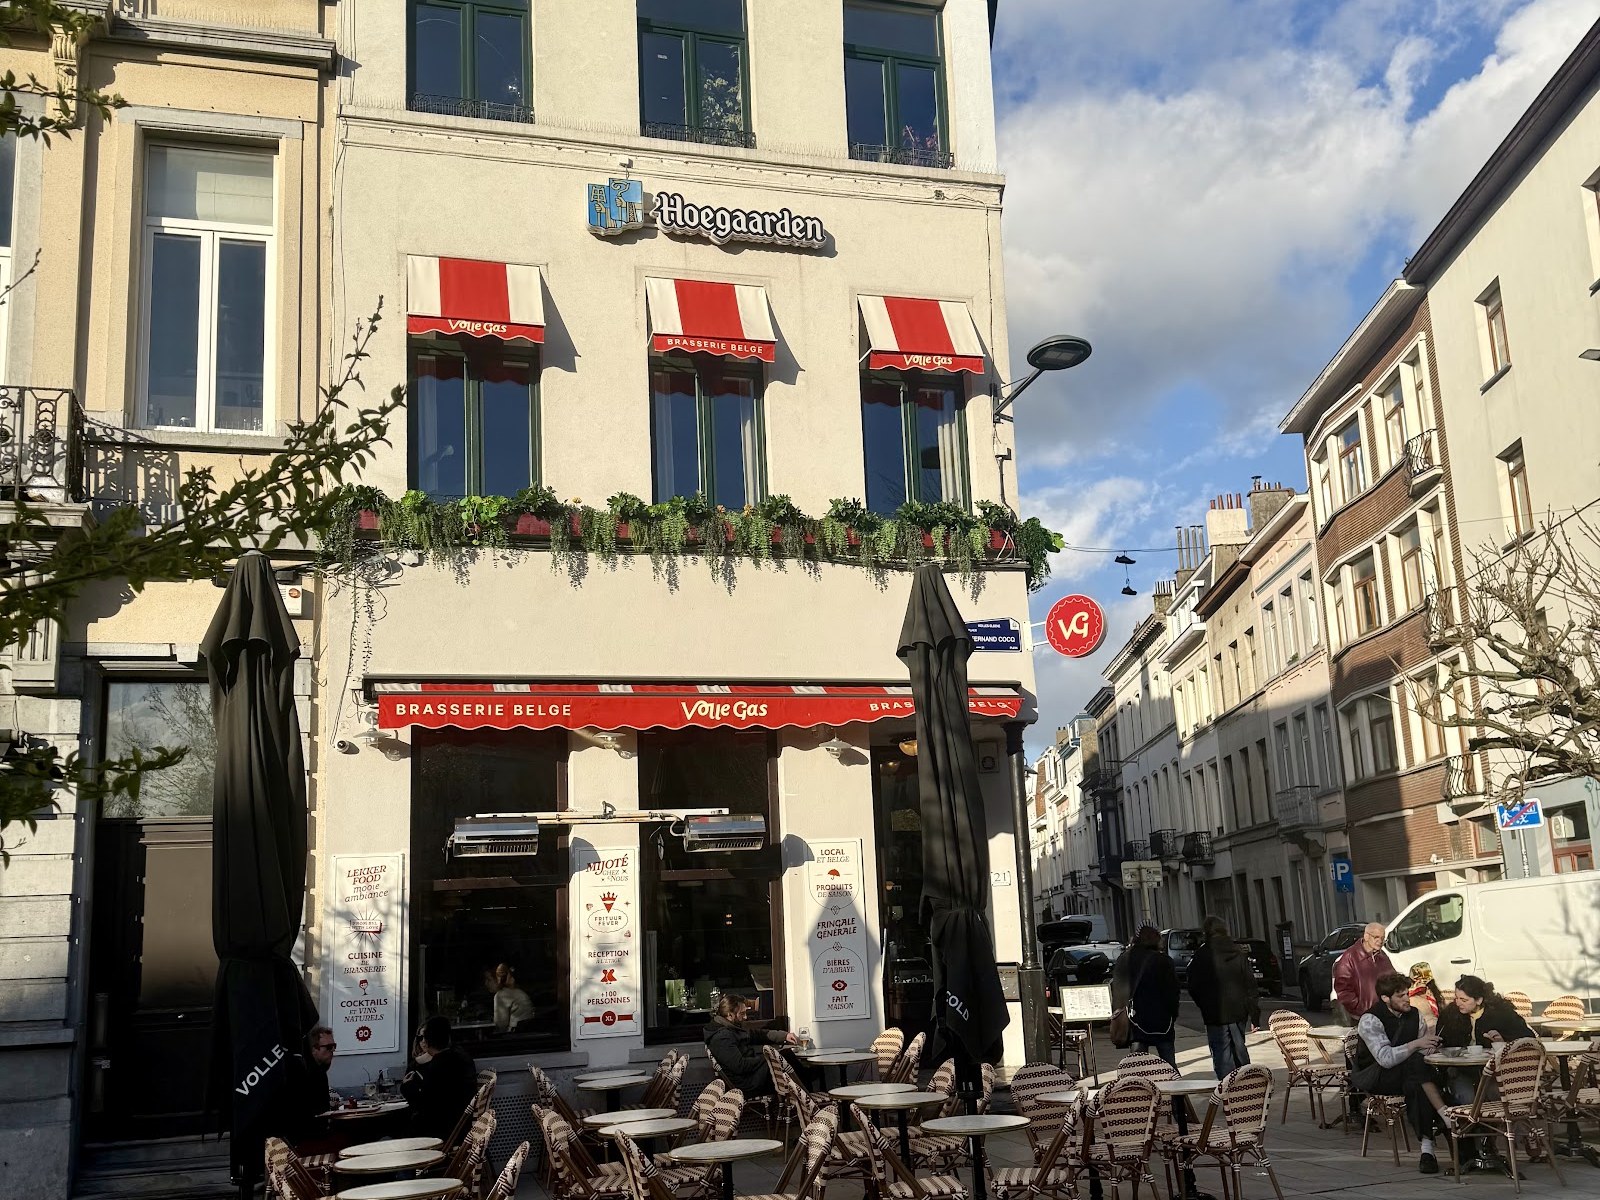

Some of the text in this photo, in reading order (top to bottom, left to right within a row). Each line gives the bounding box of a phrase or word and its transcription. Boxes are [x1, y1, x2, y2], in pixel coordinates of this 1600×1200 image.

[654, 190, 826, 245] Hoegaarden
[448, 319, 507, 333] Volle Gas
[668, 339, 763, 354] BRASSERIE BELGE
[904, 354, 953, 366] Volle Gas
[1058, 612, 1089, 640] VG
[396, 704, 571, 716] BRASSERIE BELGE
[681, 700, 768, 720] Volle Gas
[969, 701, 1011, 709] BELG
[821, 848, 845, 856] LOCAL
[586, 854, 629, 875] MIJOTÉ
[346, 864, 387, 878] LEKKER
[994, 872, 1007, 881] 21
[1336, 862, 1350, 881] P
[352, 874, 381, 885] FOOD
[354, 884, 380, 894] mooie
[828, 890, 853, 898] SAISON
[344, 890, 389, 903] ambiance
[817, 918, 856, 930] FRINGALE
[816, 926, 857, 939] GÉNÉRALE
[348, 952, 383, 960] CUISINE
[588, 950, 629, 958] RÉCEPTION
[826, 958, 850, 967] BIÈRES
[344, 966, 387, 974] BRASSERIE
[340, 998, 388, 1008] COCKTAILS
[588, 996, 631, 1005] PERSONNES
[827, 1002, 854, 1010] MAISON
[344, 1014, 385, 1023] NATURELS
[236, 1044, 285, 1096] VOLLE
